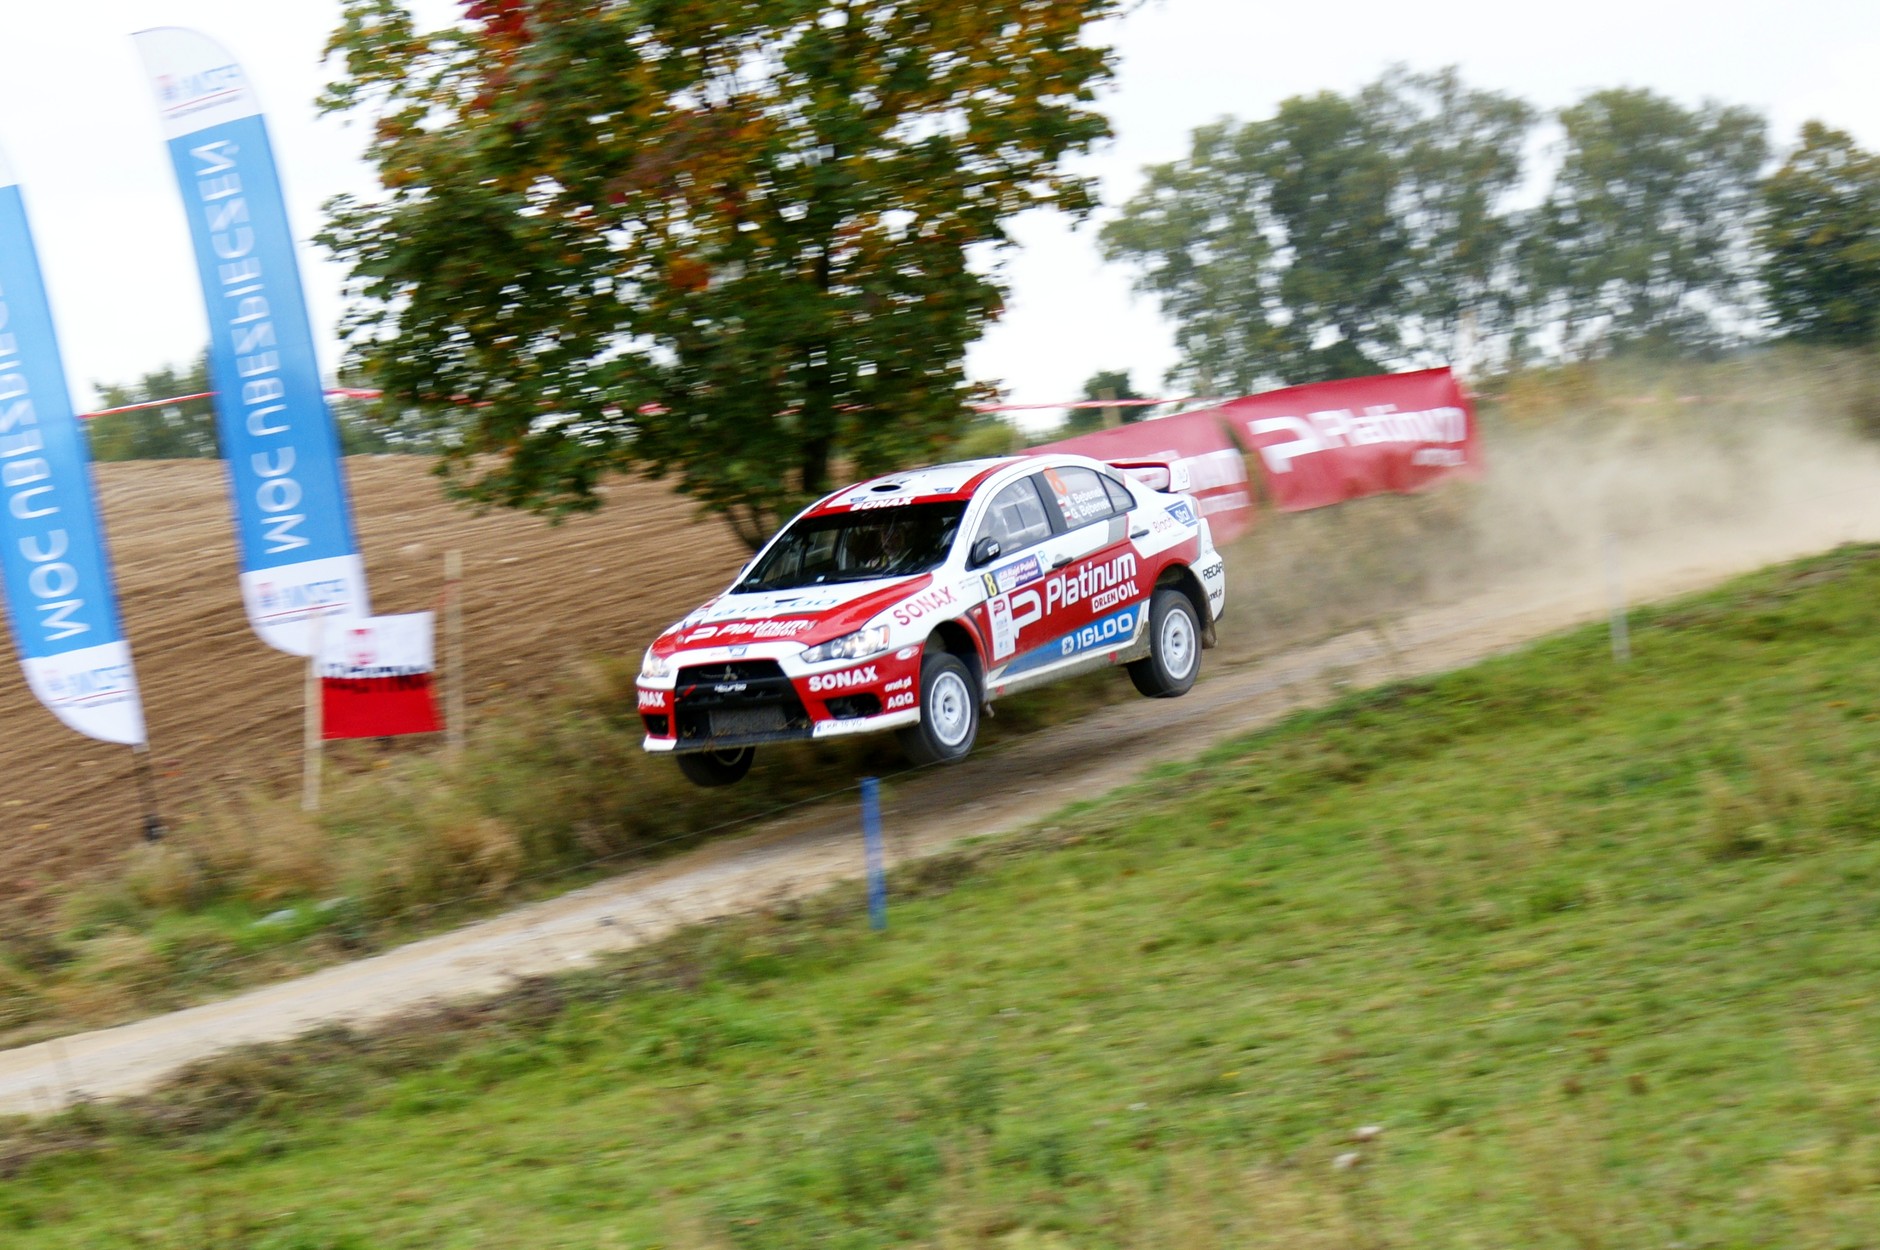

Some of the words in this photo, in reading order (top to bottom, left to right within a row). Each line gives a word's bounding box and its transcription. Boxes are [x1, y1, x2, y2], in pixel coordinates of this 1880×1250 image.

[850, 496, 917, 511] SONAX
[984, 572, 997, 597] 8
[1046, 552, 1137, 615] Platinum
[1093, 591, 1116, 609] ORLEN
[1118, 580, 1139, 600] OIL
[893, 586, 957, 626] SONAX
[1076, 613, 1133, 649] IGLOO
[808, 665, 878, 692] SONAX
[887, 692, 914, 710] AQQ
